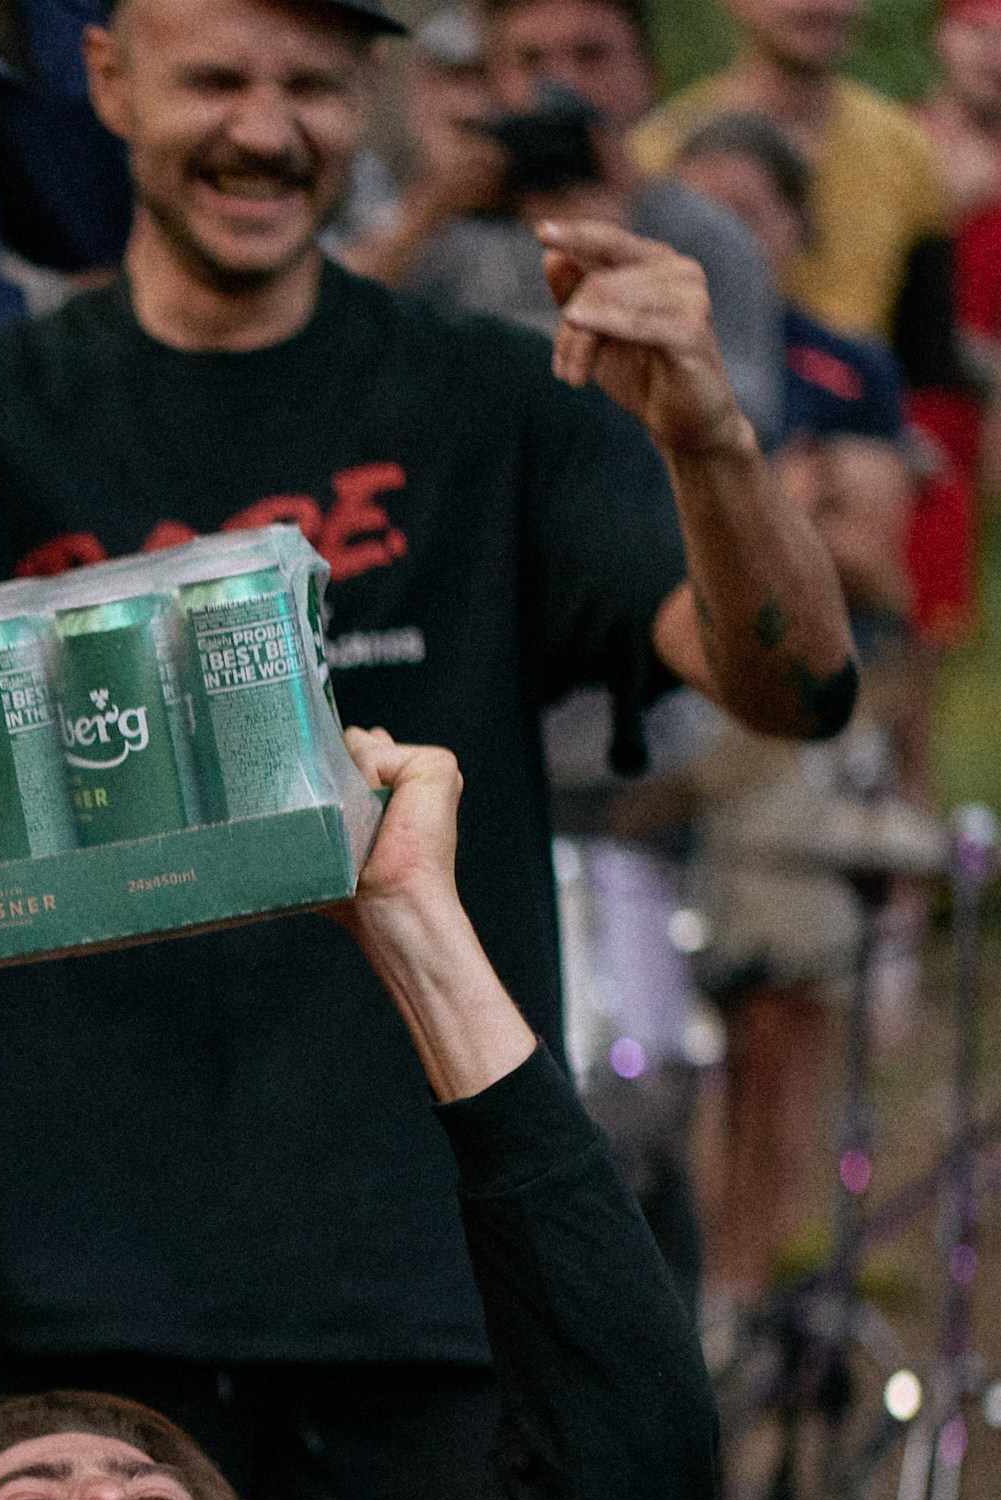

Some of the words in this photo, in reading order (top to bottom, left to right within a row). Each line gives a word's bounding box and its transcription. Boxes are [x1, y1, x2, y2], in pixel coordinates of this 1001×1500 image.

[209, 645, 261, 671] BEST
[204, 672, 220, 689] IN
[224, 665, 256, 685] THE
[13, 686, 46, 711] BES
[5, 711, 24, 729] IN
[25, 706, 47, 725] TH
